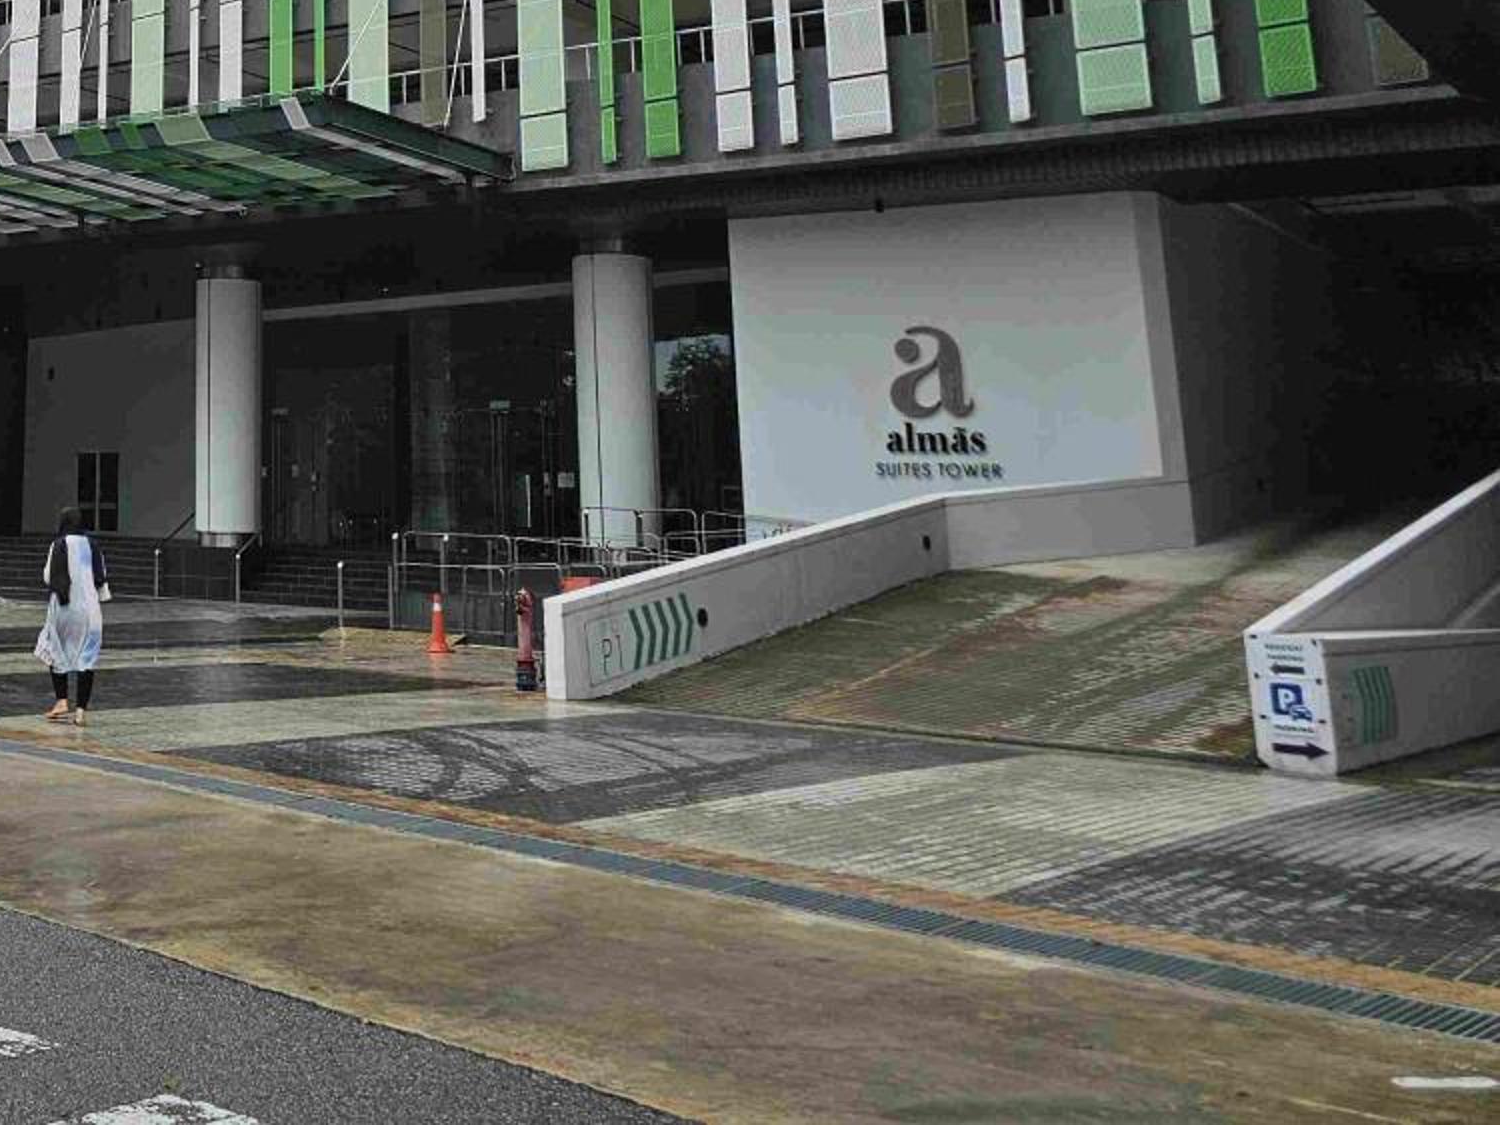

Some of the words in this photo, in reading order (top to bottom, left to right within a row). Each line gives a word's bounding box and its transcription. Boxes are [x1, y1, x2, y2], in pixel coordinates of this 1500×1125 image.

[890, 326, 975, 418] a
[876, 462, 932, 478] SUITES
[938, 463, 1003, 479] TOWER
[601, 634, 625, 676] P1
